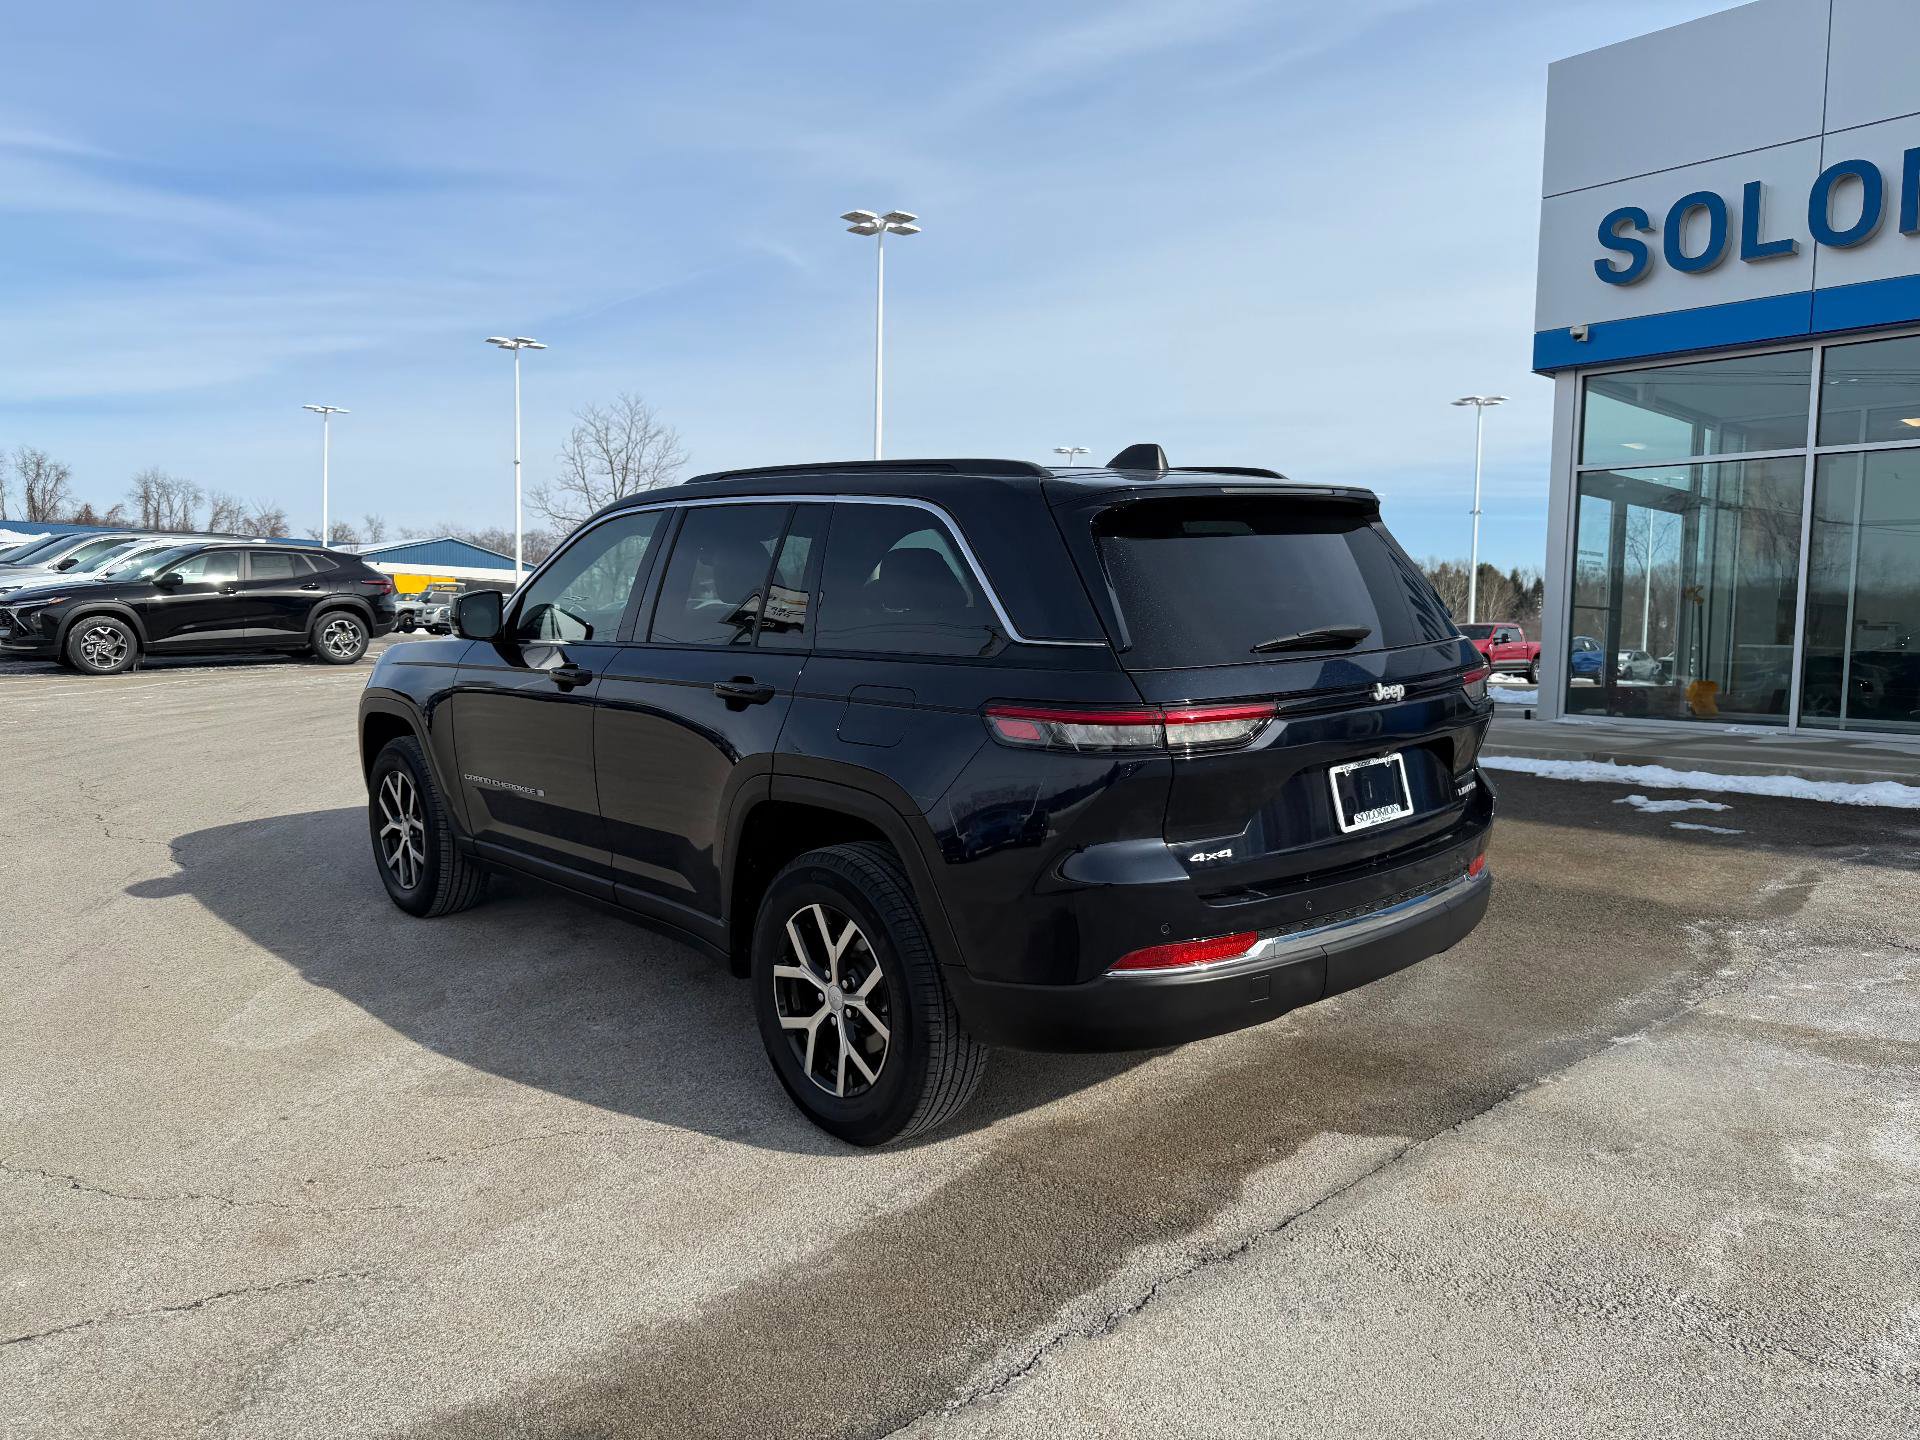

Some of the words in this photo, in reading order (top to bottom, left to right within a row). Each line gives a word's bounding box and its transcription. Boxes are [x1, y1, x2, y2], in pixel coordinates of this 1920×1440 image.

[1594, 147, 1920, 286] SOLO
[1373, 683, 1405, 701] Jeep
[464, 773, 491, 784] GRAND
[492, 780, 536, 795] CHEROKEE
[1355, 803, 1400, 824] SOLOMON
